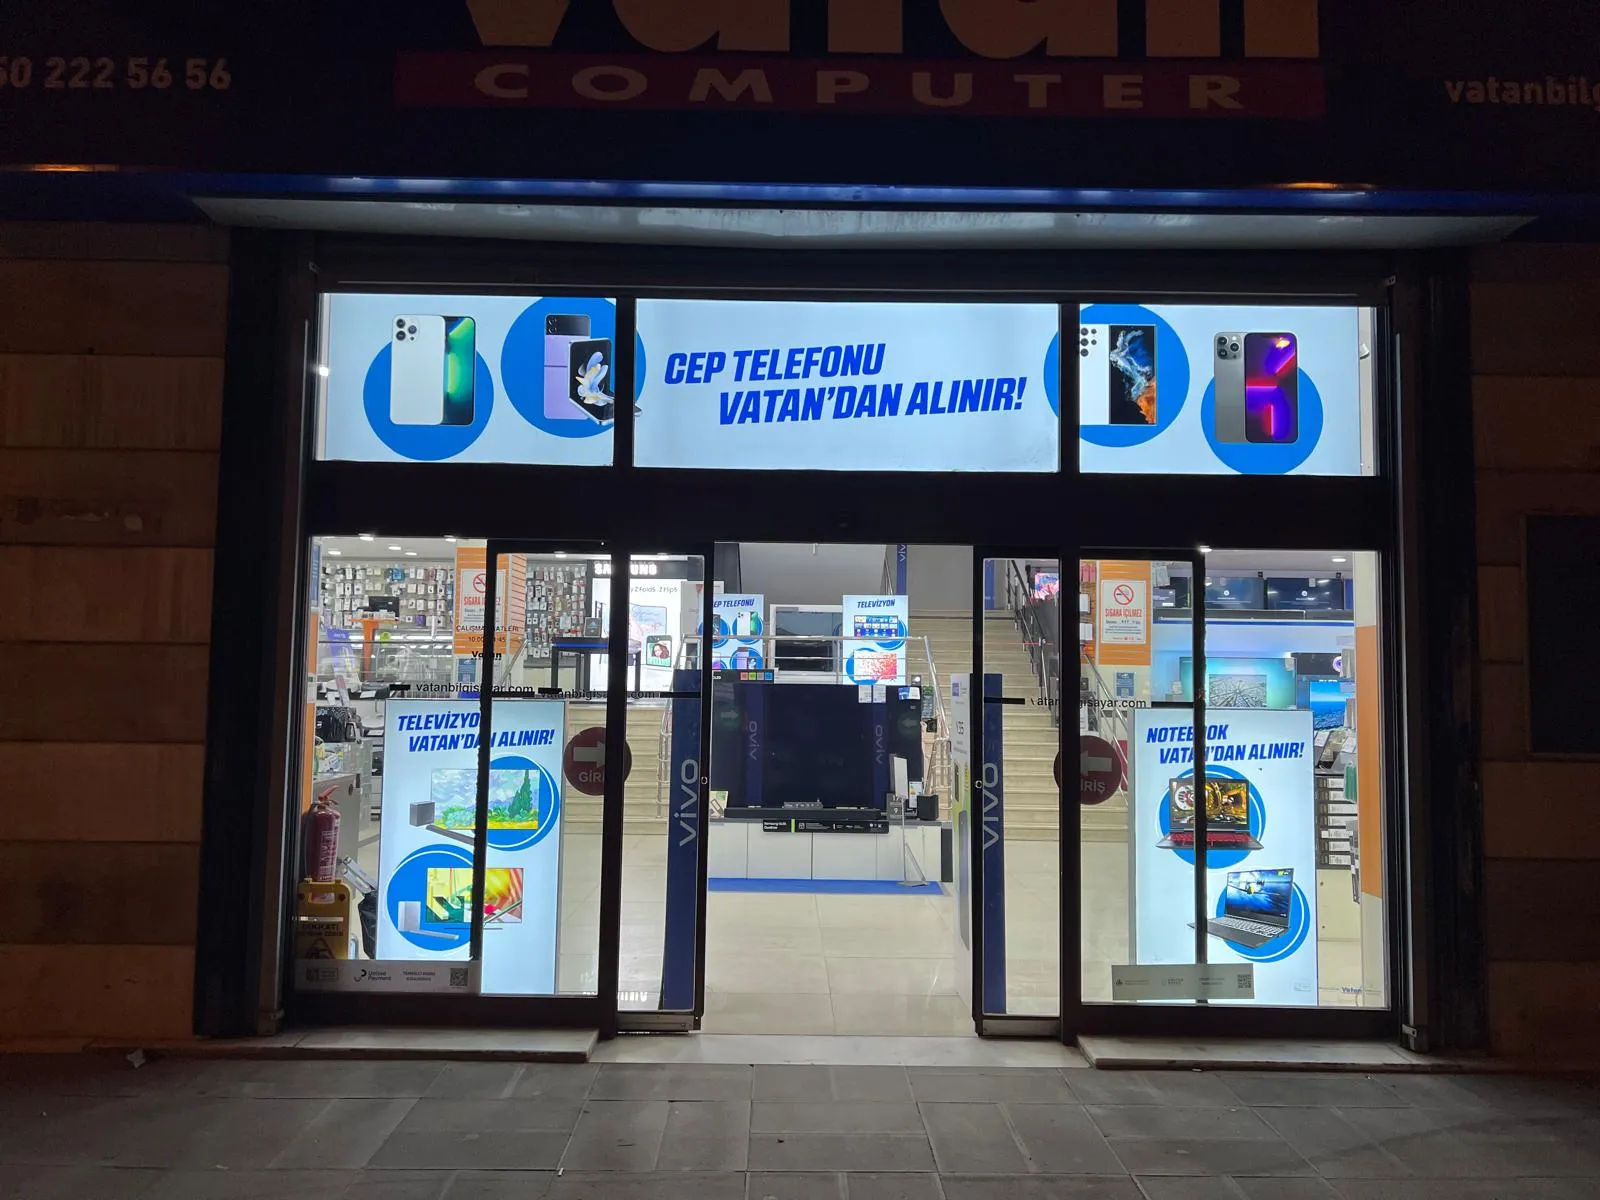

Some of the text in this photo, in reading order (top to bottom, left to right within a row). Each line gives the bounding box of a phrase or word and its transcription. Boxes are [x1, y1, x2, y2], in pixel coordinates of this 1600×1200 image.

[45, 56, 114, 89] 222
[128, 56, 173, 89] 56
[185, 57, 232, 90] 56
[474, 64, 1247, 111] COMPUTER
[664, 343, 886, 385] CEP TELEFONU
[719, 376, 1028, 426] VATAN'DAN ALINIR!
[594, 563, 657, 575] SAUNG
[723, 598, 755, 608] TELEFONU
[857, 599, 896, 609] TELEVİZYON
[398, 711, 481, 732] TELEVİZYO
[500, 729, 554, 747] ALINIR!
[1146, 724, 1229, 743] NOTEBOK
[1248, 742, 1305, 760] ALINIR!
[673, 759, 698, 847] vivo
